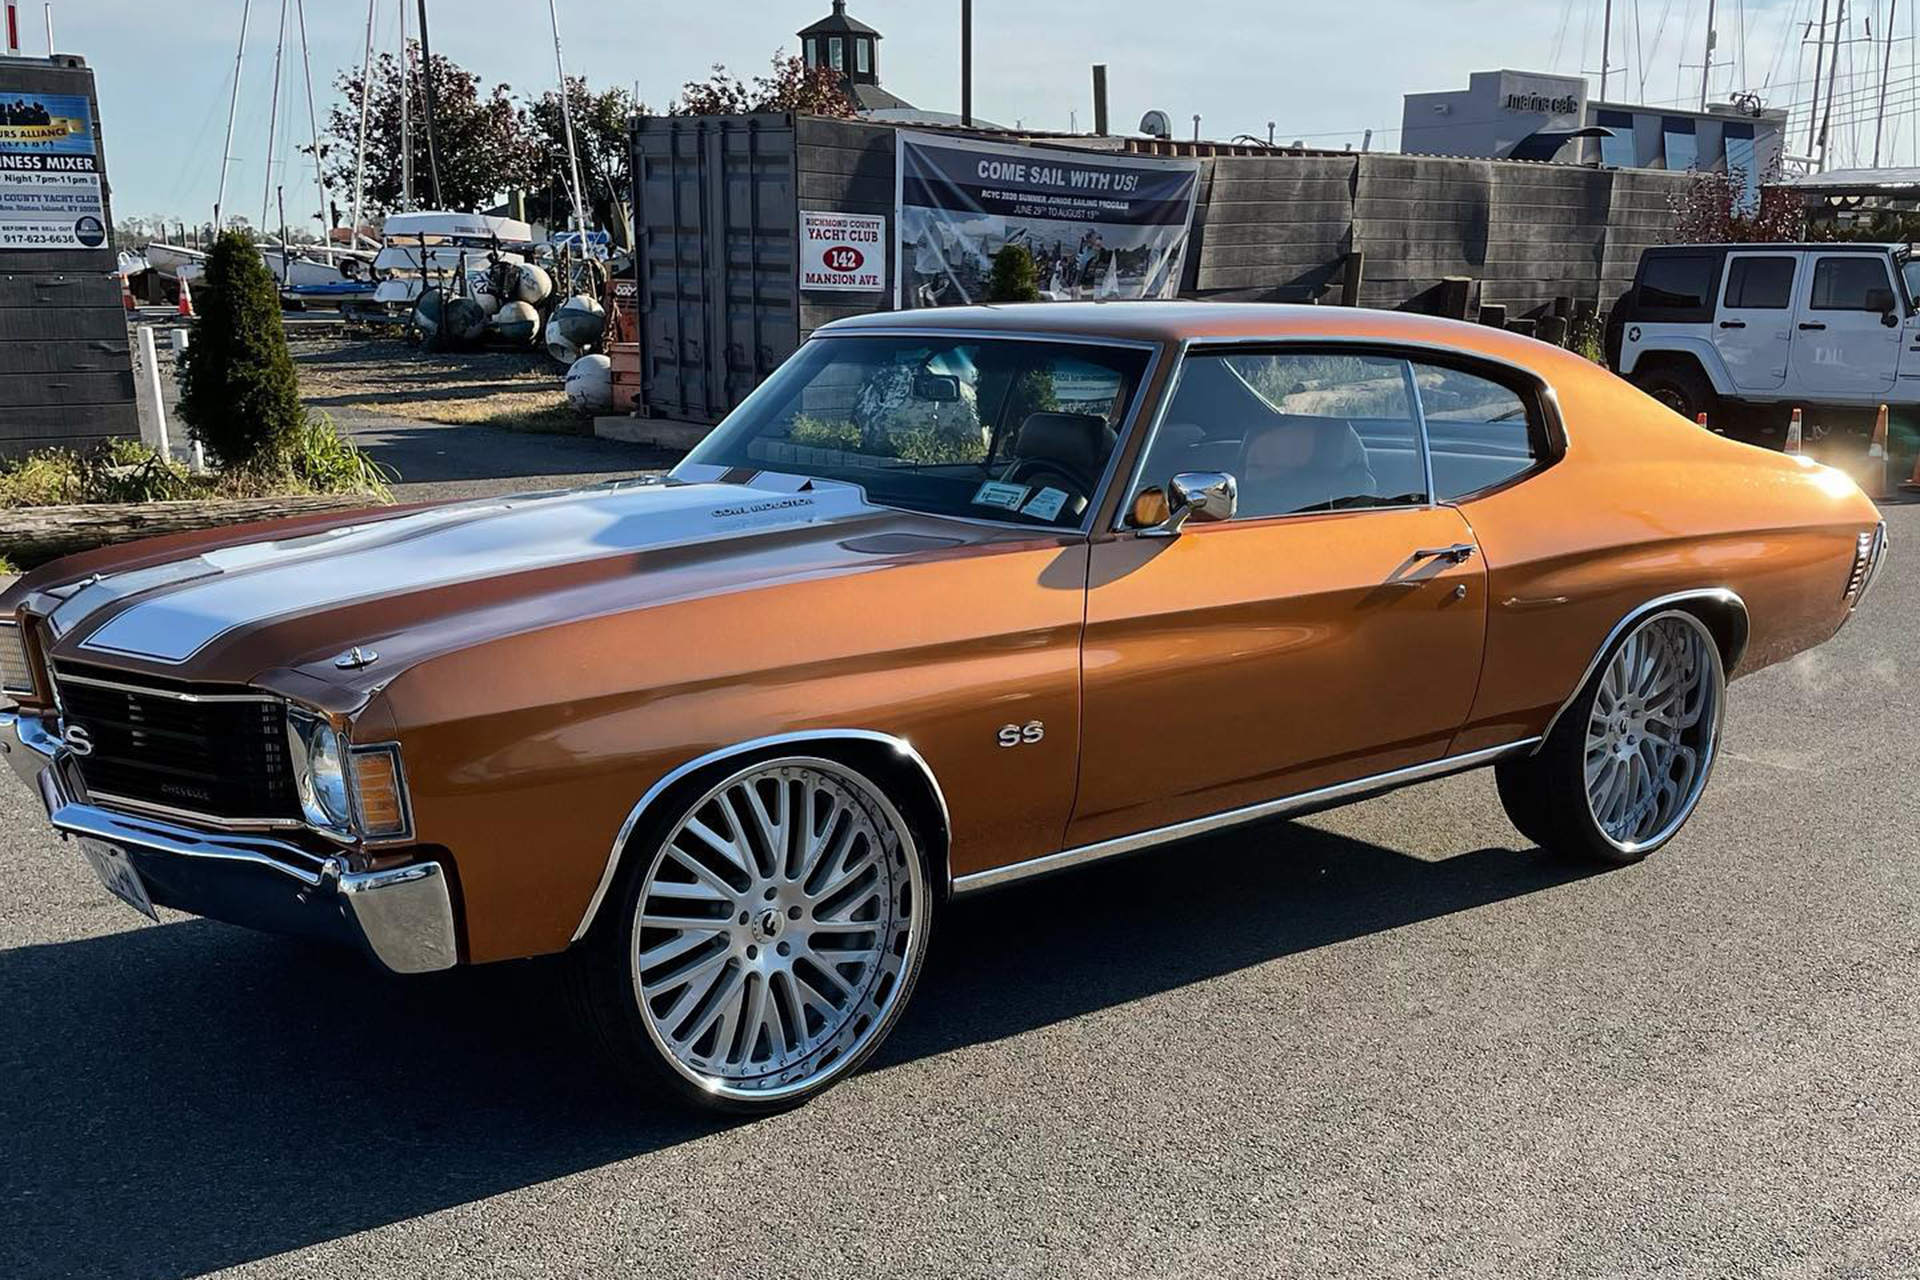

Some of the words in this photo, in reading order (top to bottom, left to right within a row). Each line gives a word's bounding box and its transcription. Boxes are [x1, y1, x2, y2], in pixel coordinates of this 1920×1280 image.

[46, 156, 94, 170] MIXER
[4, 174, 33, 184] Night
[35, 174, 88, 185] 7pm-11pm
[977, 160, 1026, 182] COME
[1030, 166, 1066, 186] SAIL
[1070, 170, 1110, 190] WITH
[1113, 174, 1138, 192] US!
[3, 193, 42, 202] COUNTY
[43, 194, 74, 203] YACHT
[75, 195, 99, 203] CLUB
[981, 189, 1001, 199] RCYC
[1047, 196, 1072, 205] JUNIOR
[1073, 198, 1098, 207] SAILING
[1098, 200, 1130, 209] PROGRAM
[1013, 204, 1033, 214] JUNE
[1048, 207, 1057, 216] TO
[1058, 208, 1086, 218] AUGUST
[805, 218, 848, 228] RICHMOND
[849, 220, 880, 229] COUNTY
[808, 228, 847, 241] YACHT
[849, 231, 878, 242] CLUB
[831, 251, 856, 268] 142
[805, 273, 856, 285] MANSION
[858, 275, 880, 286] AVE.
[711, 506, 749, 518] COWL
[750, 498, 815, 512] INDUCTION
[997, 720, 1045, 748] SS
